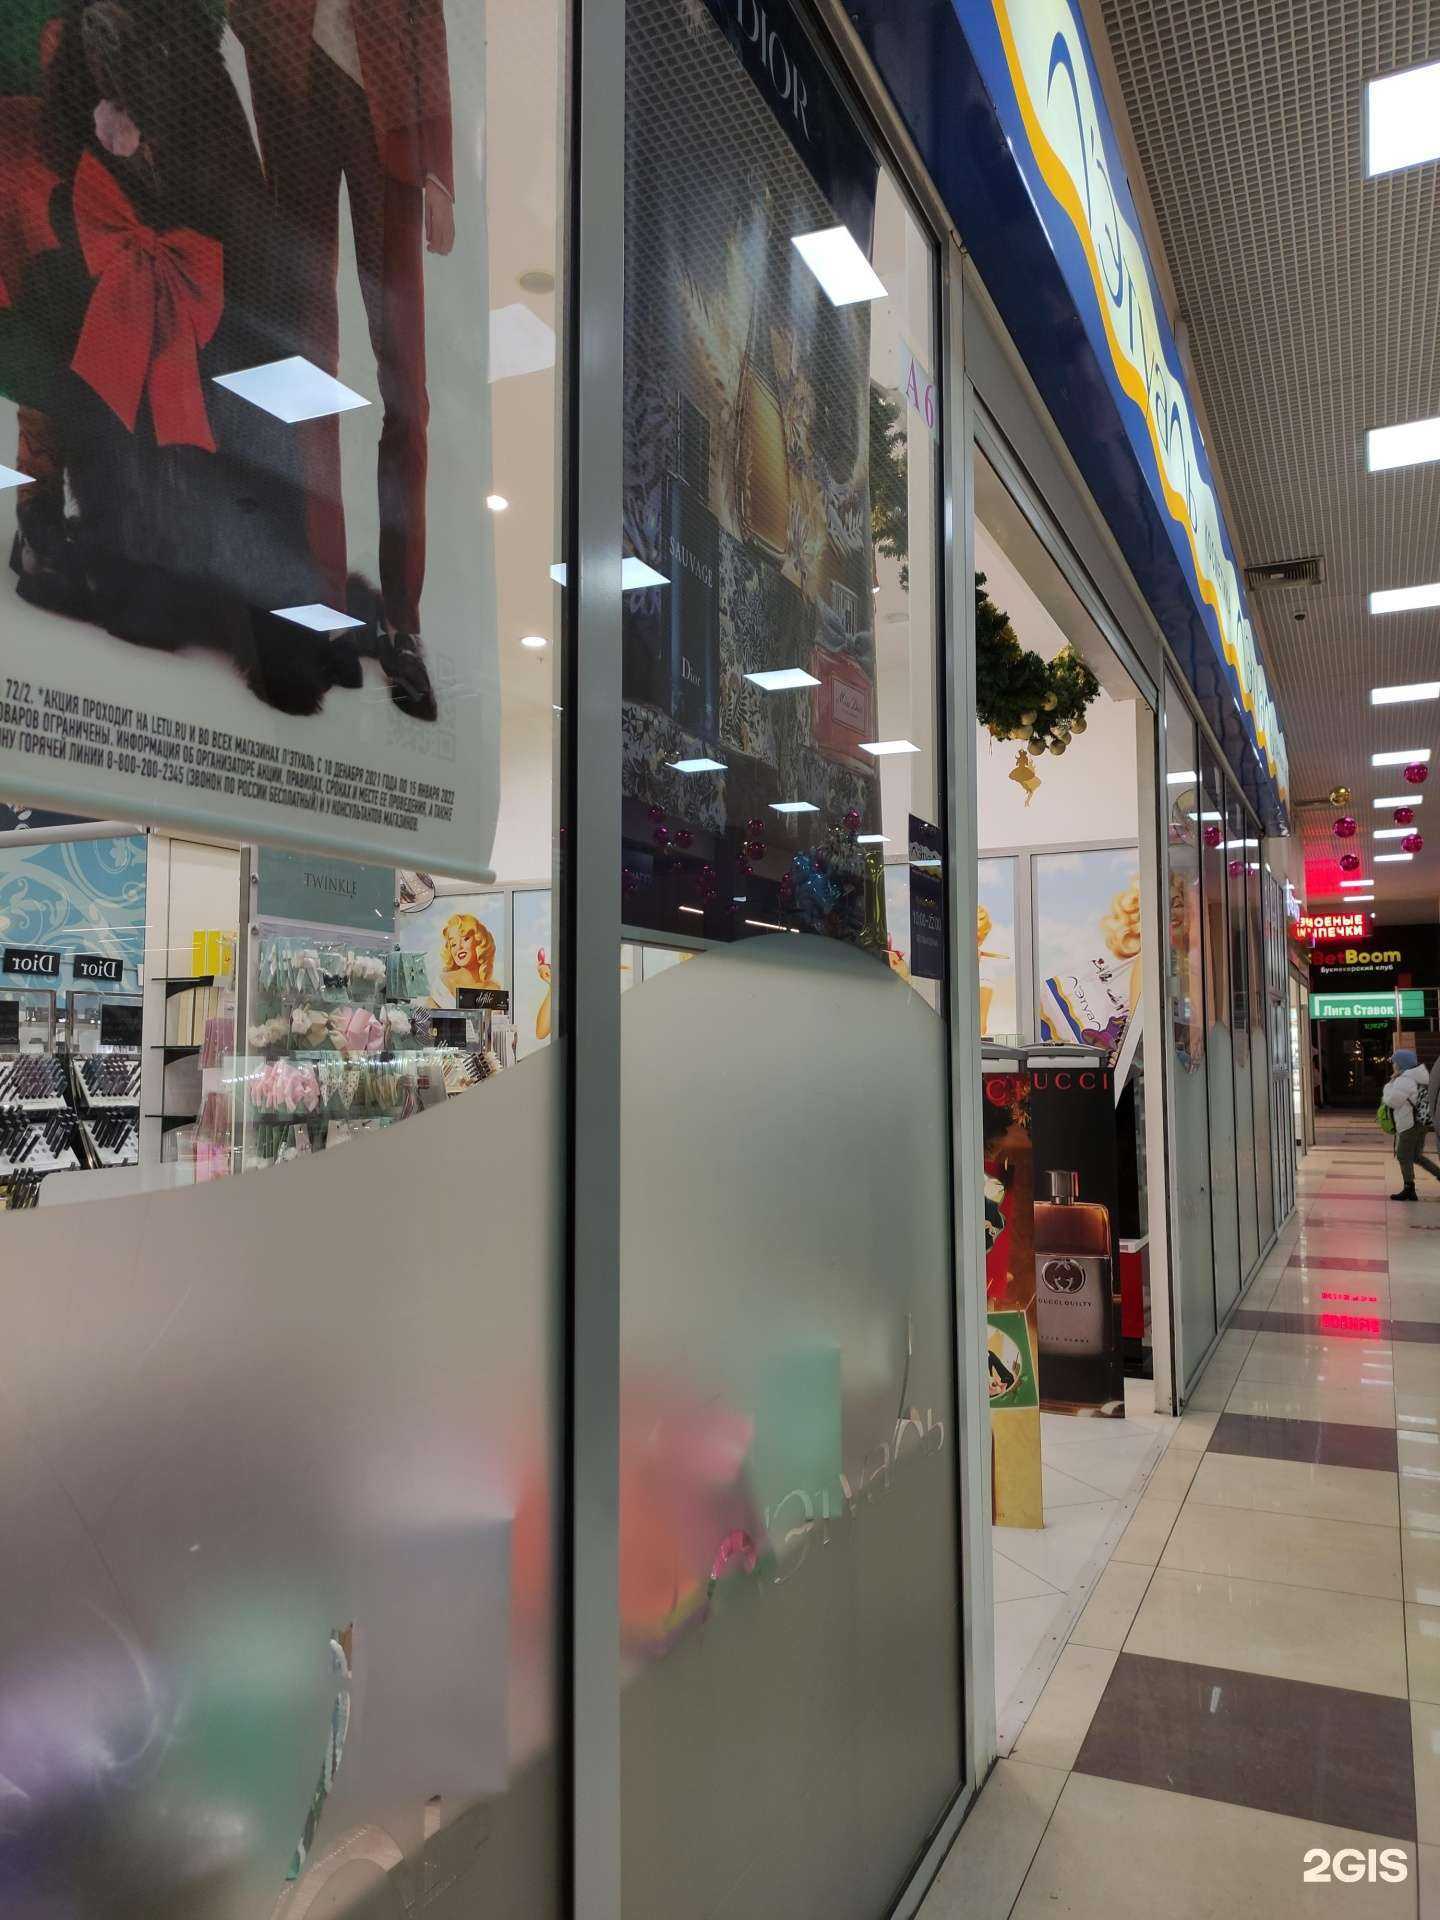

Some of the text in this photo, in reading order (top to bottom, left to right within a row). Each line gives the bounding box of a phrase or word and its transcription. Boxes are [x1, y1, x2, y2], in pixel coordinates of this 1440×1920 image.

[737, 0, 811, 142] DIOR
[670, 535, 713, 588] SAUVAGE
[681, 655, 702, 687] Dior
[6, 679, 33, 704] 72/2.
[82, 698, 133, 729] ПРОХОДИТ
[136, 711, 149, 732] НА
[152, 715, 187, 741] LETU.RU
[189, 725, 196, 743] И
[198, 727, 209, 746] ВО
[212, 731, 232, 752] ВСЕХ
[234, 735, 280, 763] МАГАЗИНАХ
[317, 757, 323, 773] С
[333, 761, 364, 783] ДЕКАБРЯ
[43, 712, 114, 747] ОГРАНИЧЕНЫ.
[116, 730, 181, 761] ИНФОРМАЦИЯ
[183, 746, 195, 764] ОБ
[196, 748, 256, 779] ОРГАНИЗАТОРЕ
[19, 731, 66, 761] ГОРЯЧЕЙ
[68, 742, 104, 768] ЛИНИИ
[106, 750, 184, 785] 8-800-200-2345
[224, 775, 236, 795] ПО
[237, 779, 268, 802] РОССИИ
[303, 872, 358, 897] TWINKLE
[1323, 1004, 1394, 1017] Лига Ставок
[1032, 1071, 1110, 1090] UCCI
